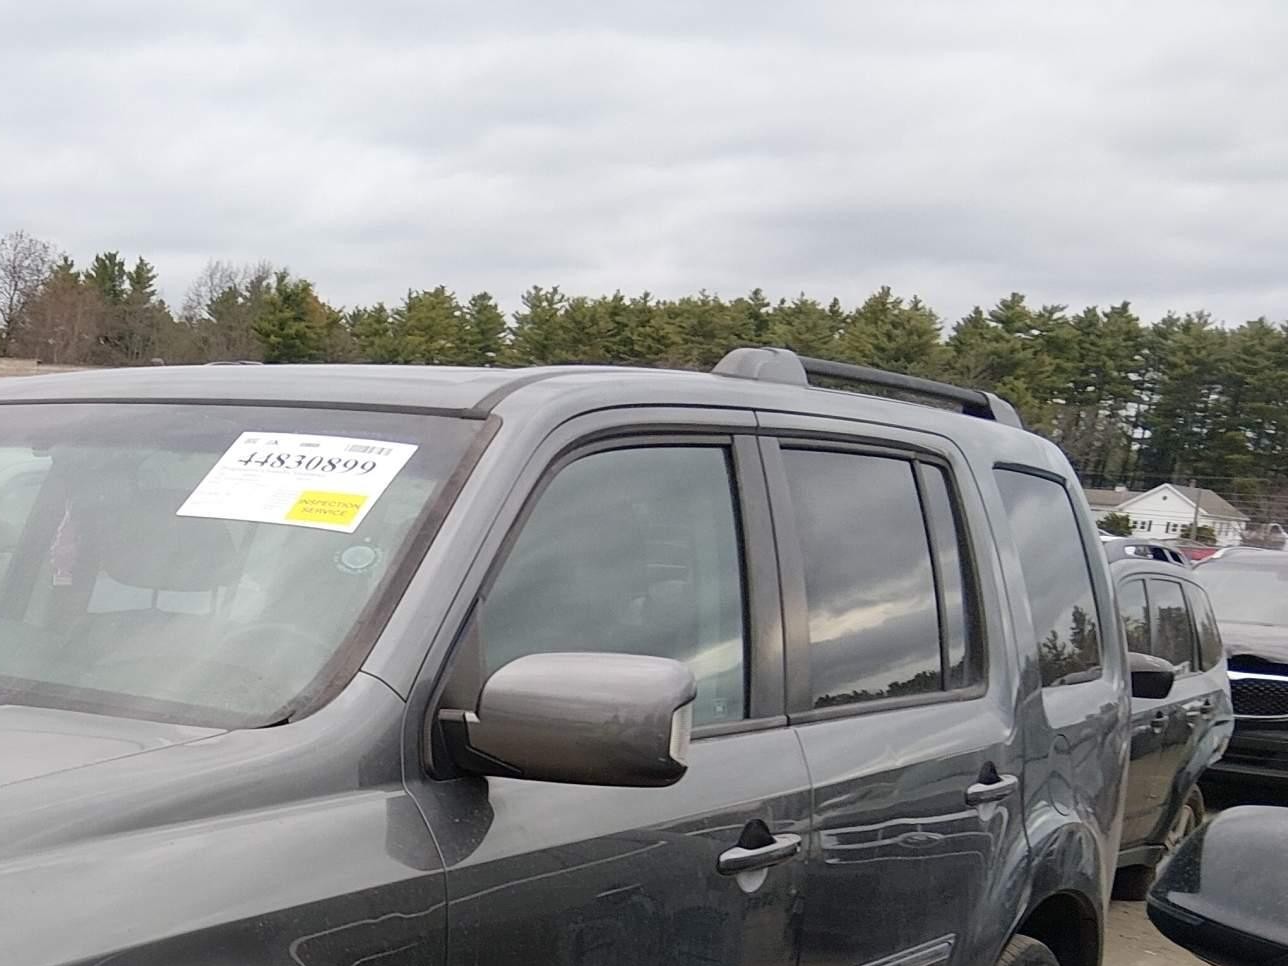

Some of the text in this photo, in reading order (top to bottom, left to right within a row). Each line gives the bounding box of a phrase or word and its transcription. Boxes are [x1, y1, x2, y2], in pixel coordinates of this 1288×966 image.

[238, 451, 377, 476] 44830899
[299, 498, 361, 511] INSPECTION
[302, 506, 349, 517] SERVICE
